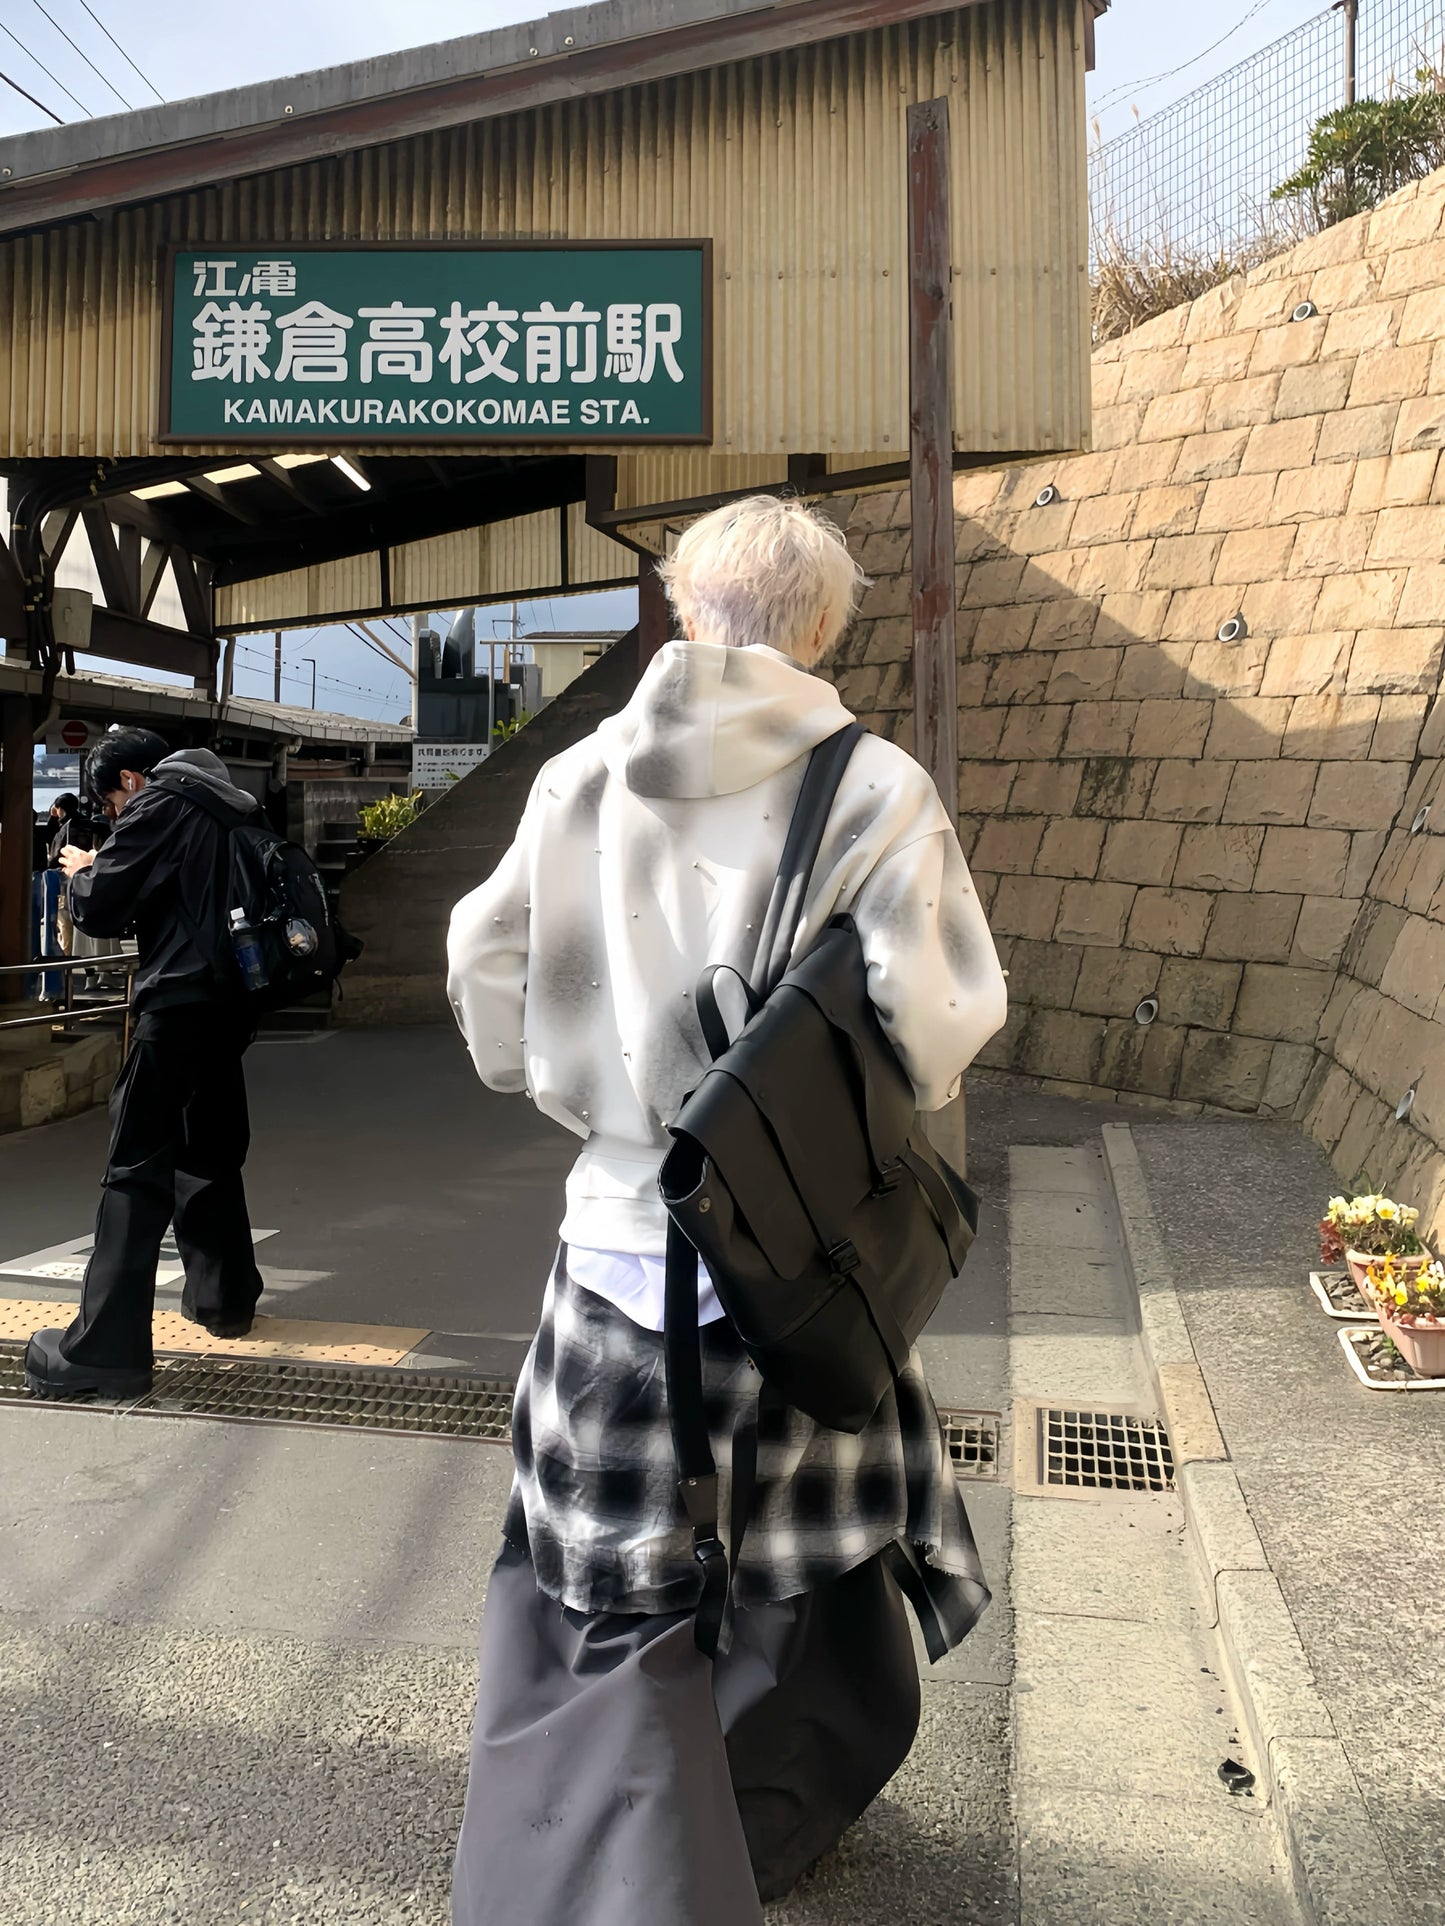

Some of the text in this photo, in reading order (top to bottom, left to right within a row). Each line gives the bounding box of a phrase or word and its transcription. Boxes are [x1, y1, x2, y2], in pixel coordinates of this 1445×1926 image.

[193, 261, 296, 296] 江ノ電
[191, 301, 684, 384] 鎌倉高校前駅
[224, 398, 650, 425] KAMAKURAKOKOMAE STA.
